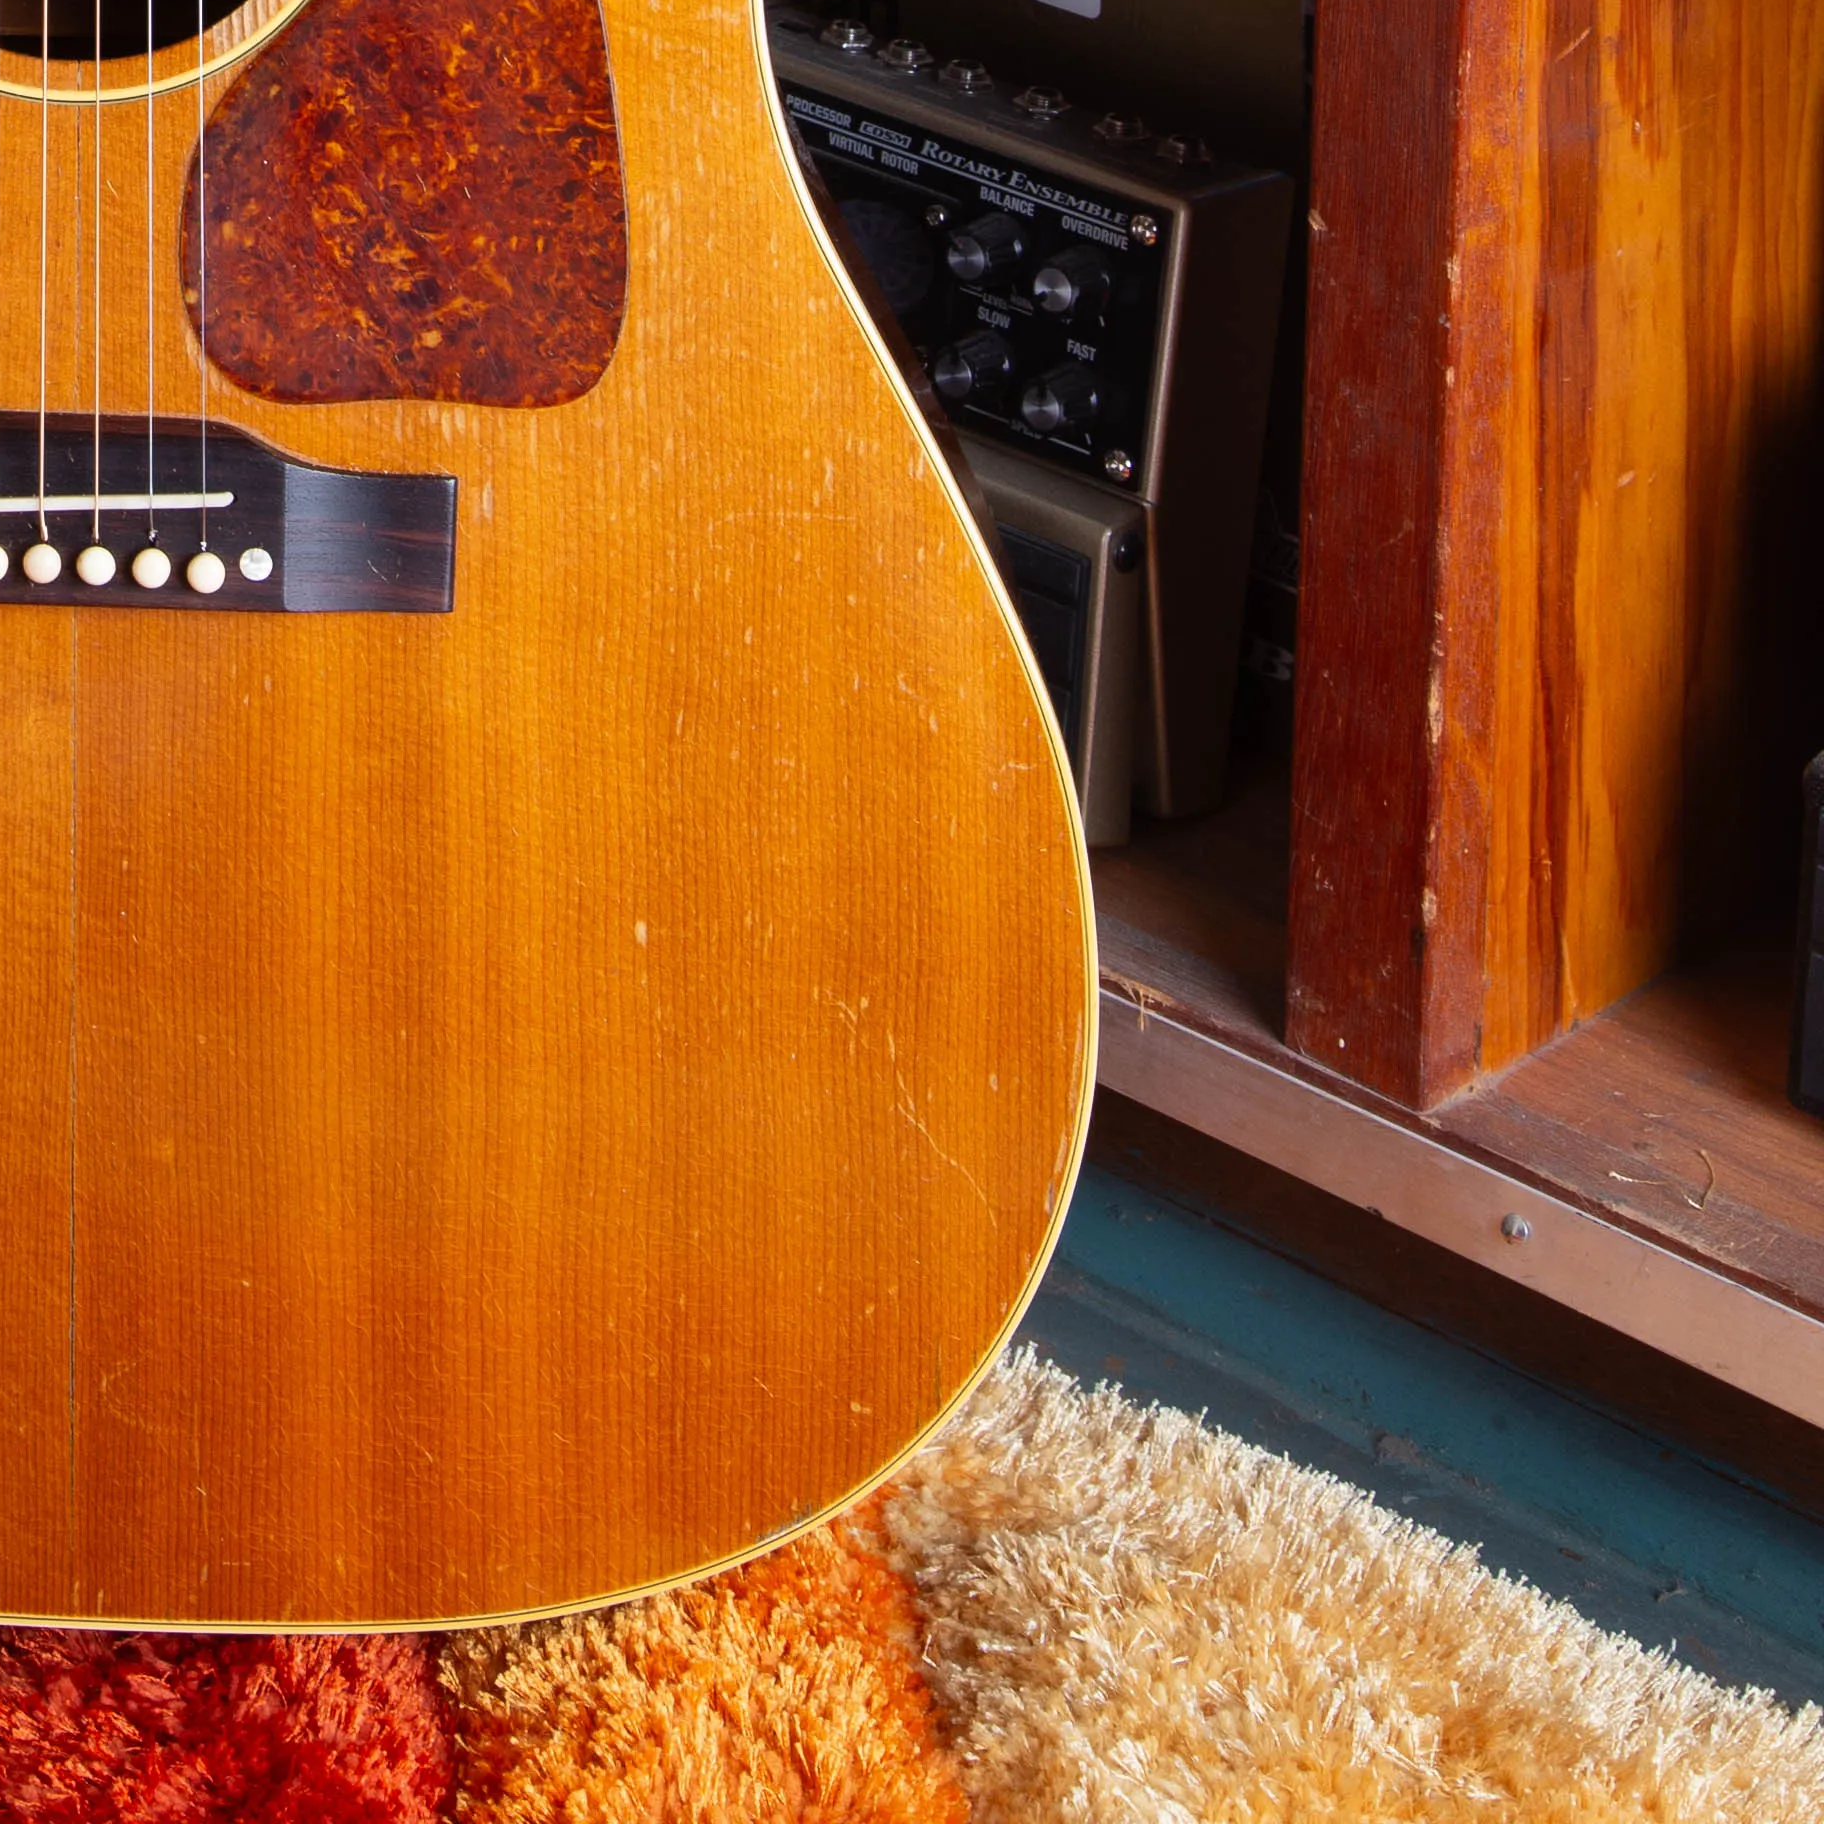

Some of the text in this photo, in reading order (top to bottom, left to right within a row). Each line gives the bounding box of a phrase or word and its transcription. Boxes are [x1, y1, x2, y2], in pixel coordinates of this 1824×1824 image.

[786, 93, 853, 129] PROCESSOR
[919, 139, 1009, 183] ROTARY
[1007, 169, 1130, 228] ENSEMBLE
[828, 131, 920, 178] VIRTUAL ROTOR
[979, 186, 1036, 218] BALANCE
[1060, 214, 1130, 252] OVERDRIVE
[976, 305, 1012, 330] SLOW
[1066, 337, 1097, 362] FAST
